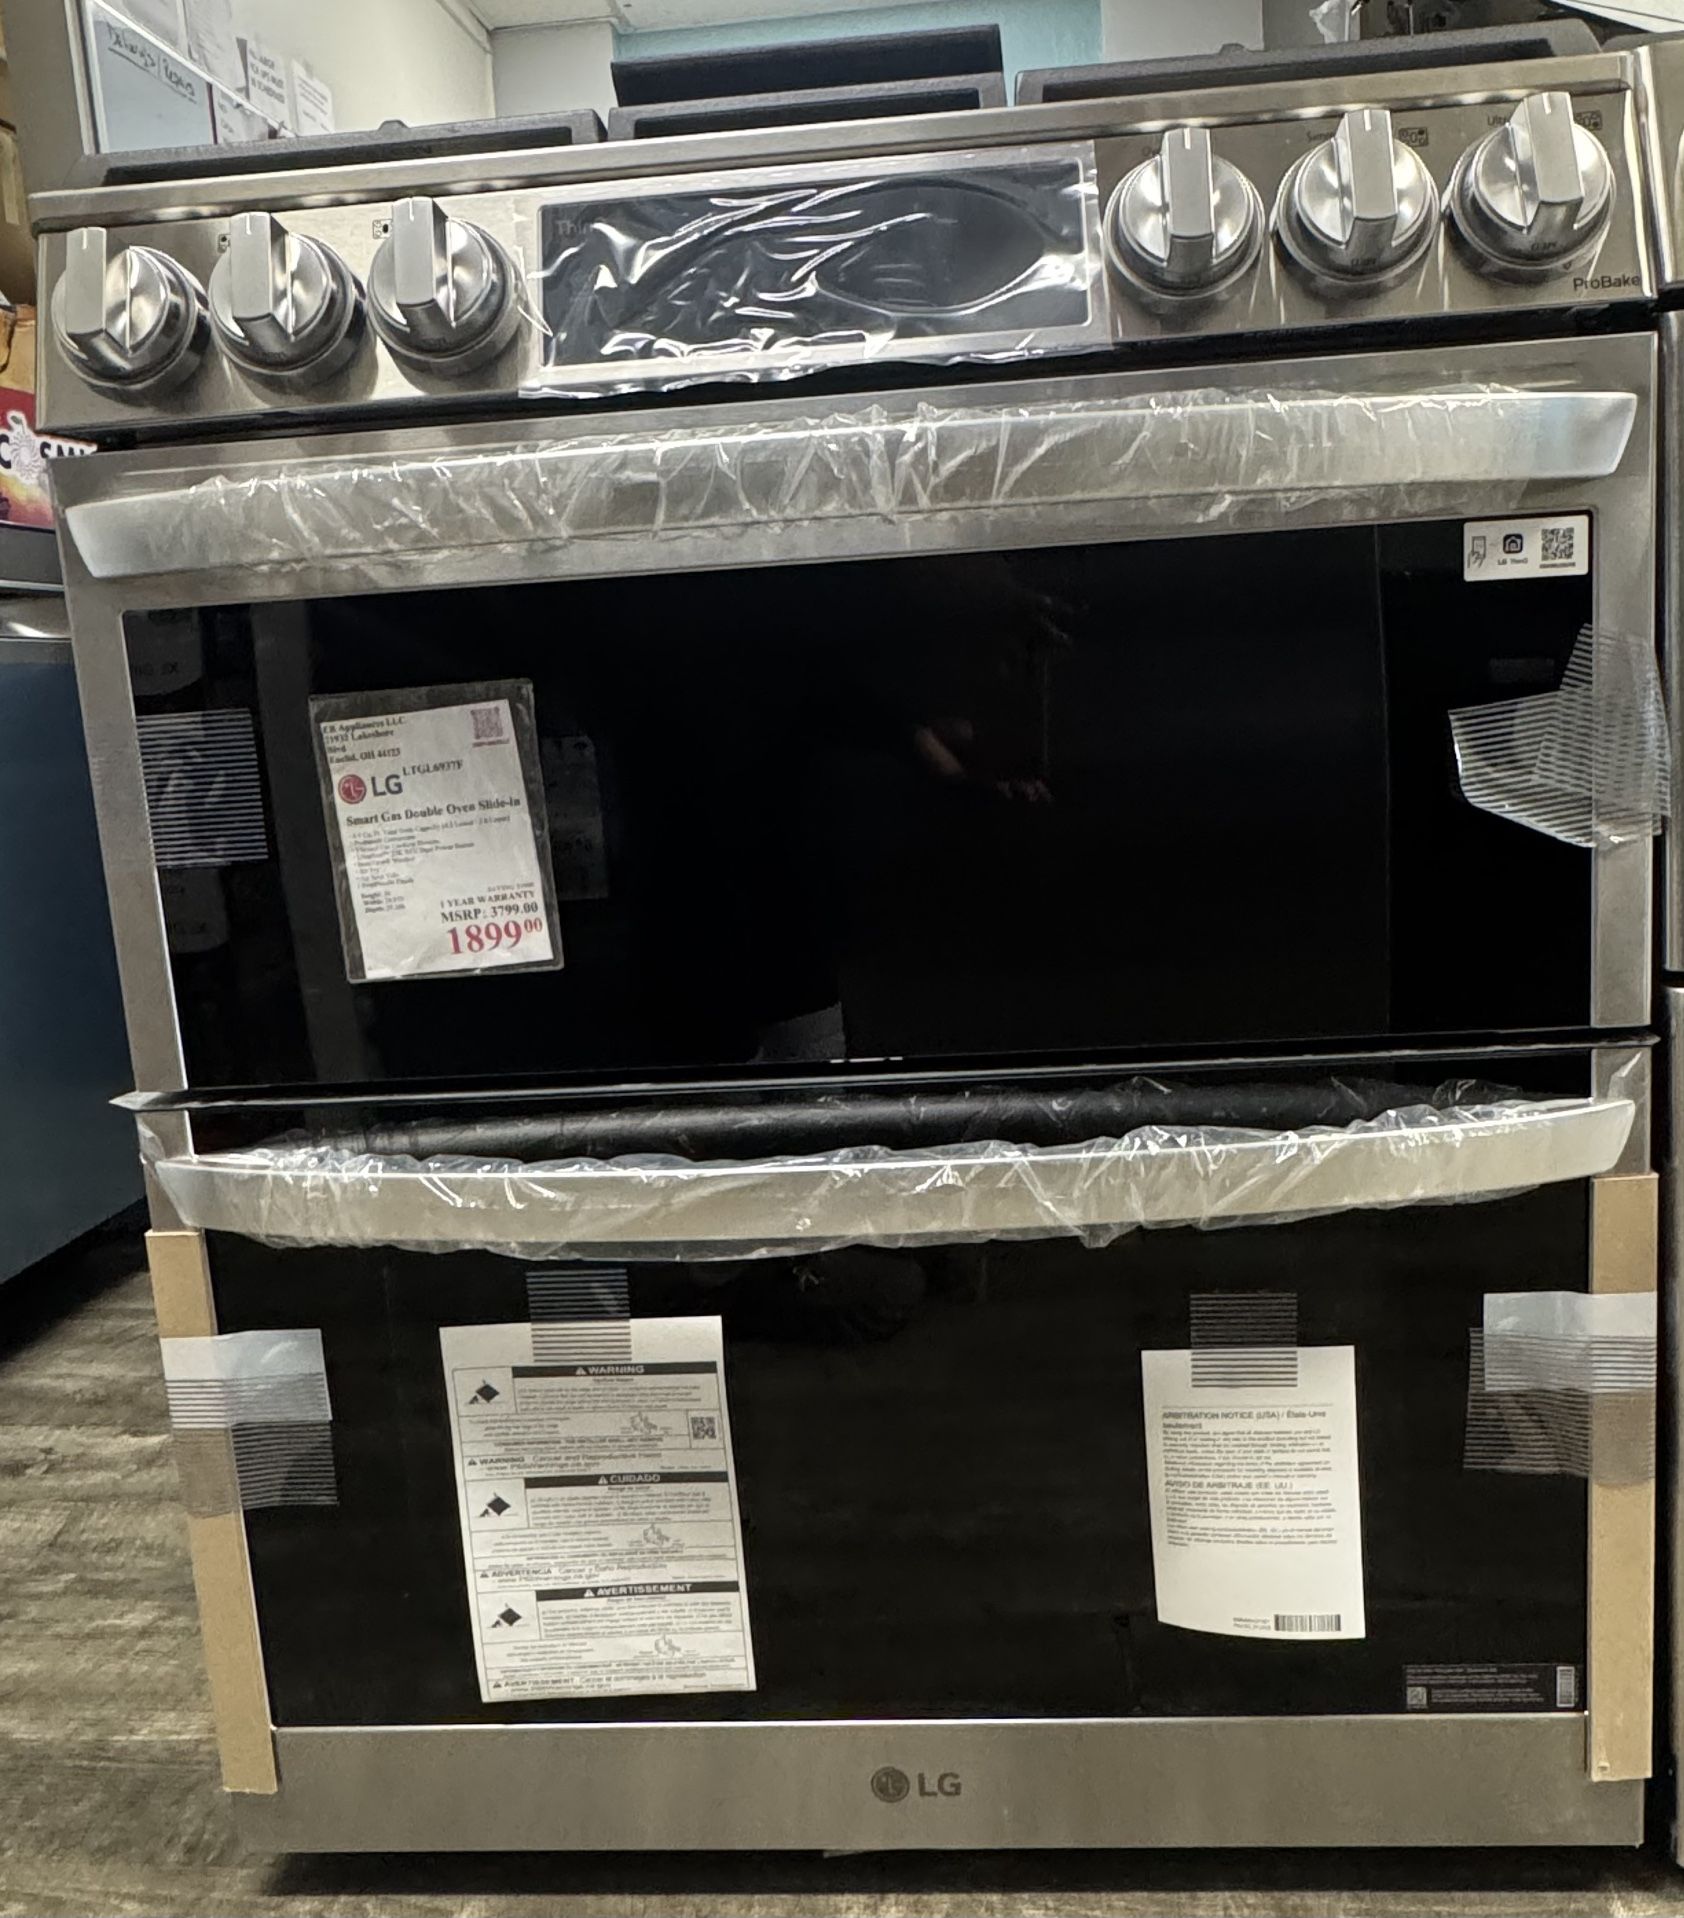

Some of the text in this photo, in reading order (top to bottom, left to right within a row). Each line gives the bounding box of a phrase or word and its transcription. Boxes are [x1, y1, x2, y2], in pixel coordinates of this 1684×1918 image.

[1573, 274, 1640, 291] ProBake
[371, 774, 403, 797] LG
[346, 814, 378, 827] Smart
[381, 811, 401, 823] Gas
[405, 806, 444, 821] Double
[446, 802, 475, 815] Oven
[446, 897, 474, 908] YEAR
[477, 890, 535, 903] WARRANTY
[440, 901, 538, 923] MSRP: 3799.00
[588, 1365, 645, 1375] WARNING
[1162, 1411, 1219, 1420] ARBITRATION
[1221, 1411, 1254, 1420] NOTICE
[479, 1456, 525, 1465] WARNING
[610, 1474, 661, 1483] CUIDADO
[1192, 1481, 1204, 1489] DE
[1206, 1480, 1254, 1489] ARBITRAJE
[492, 1569, 552, 1578] ADVERTENCIA
[596, 1583, 692, 1596] AVERTISSEMENT
[917, 1772, 962, 1797] LG
